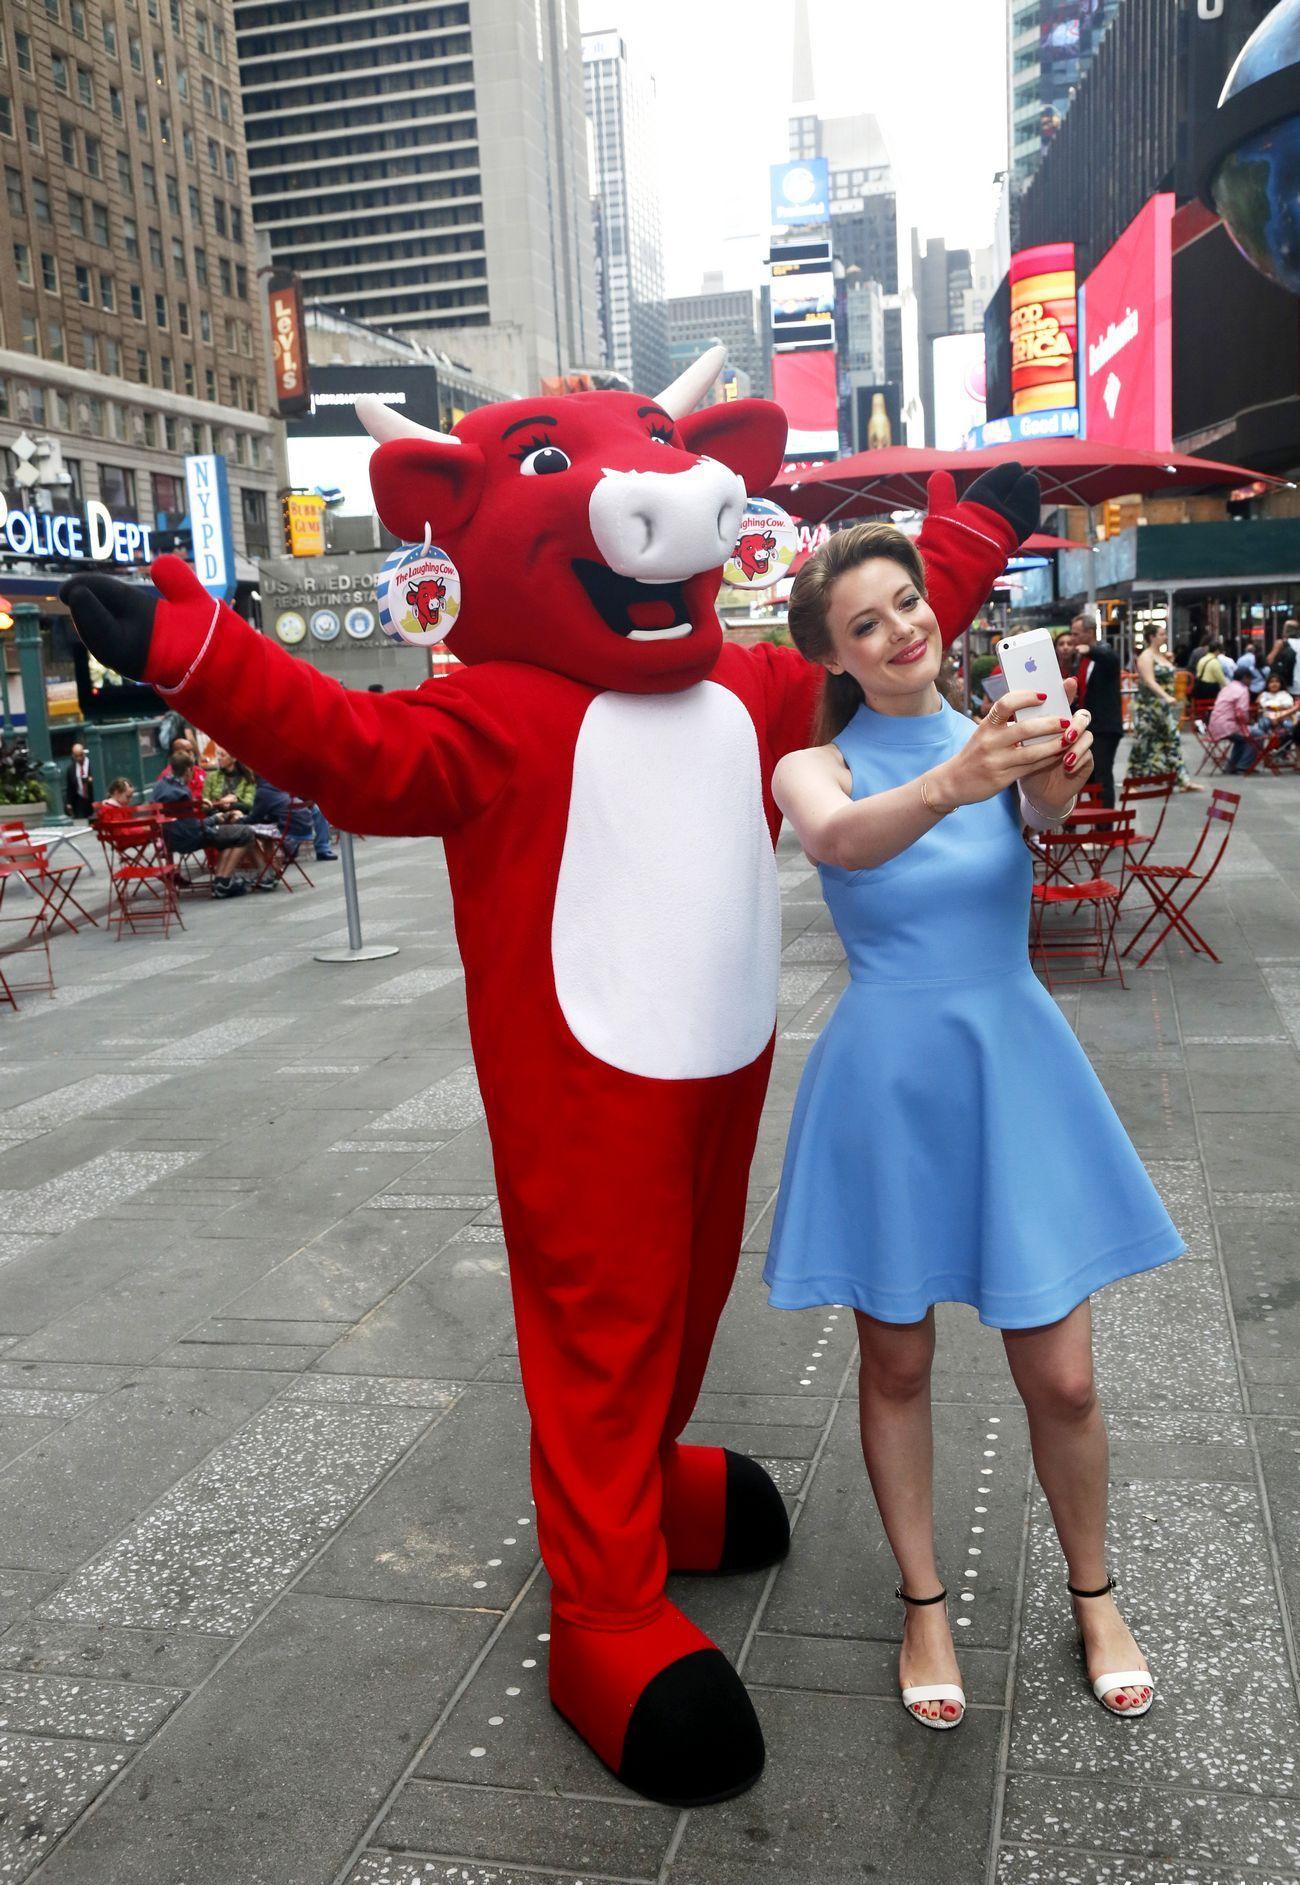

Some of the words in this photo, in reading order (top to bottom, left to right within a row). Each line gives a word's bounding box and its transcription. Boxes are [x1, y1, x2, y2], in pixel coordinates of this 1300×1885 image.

[0, 491, 84, 557] OLICE
[86, 500, 152, 563] DEPT
[194, 461, 217, 580] NYPD
[395, 572, 409, 587] The
[408, 562, 440, 578] Laughing
[273, 591, 351, 608] RECRUITING
